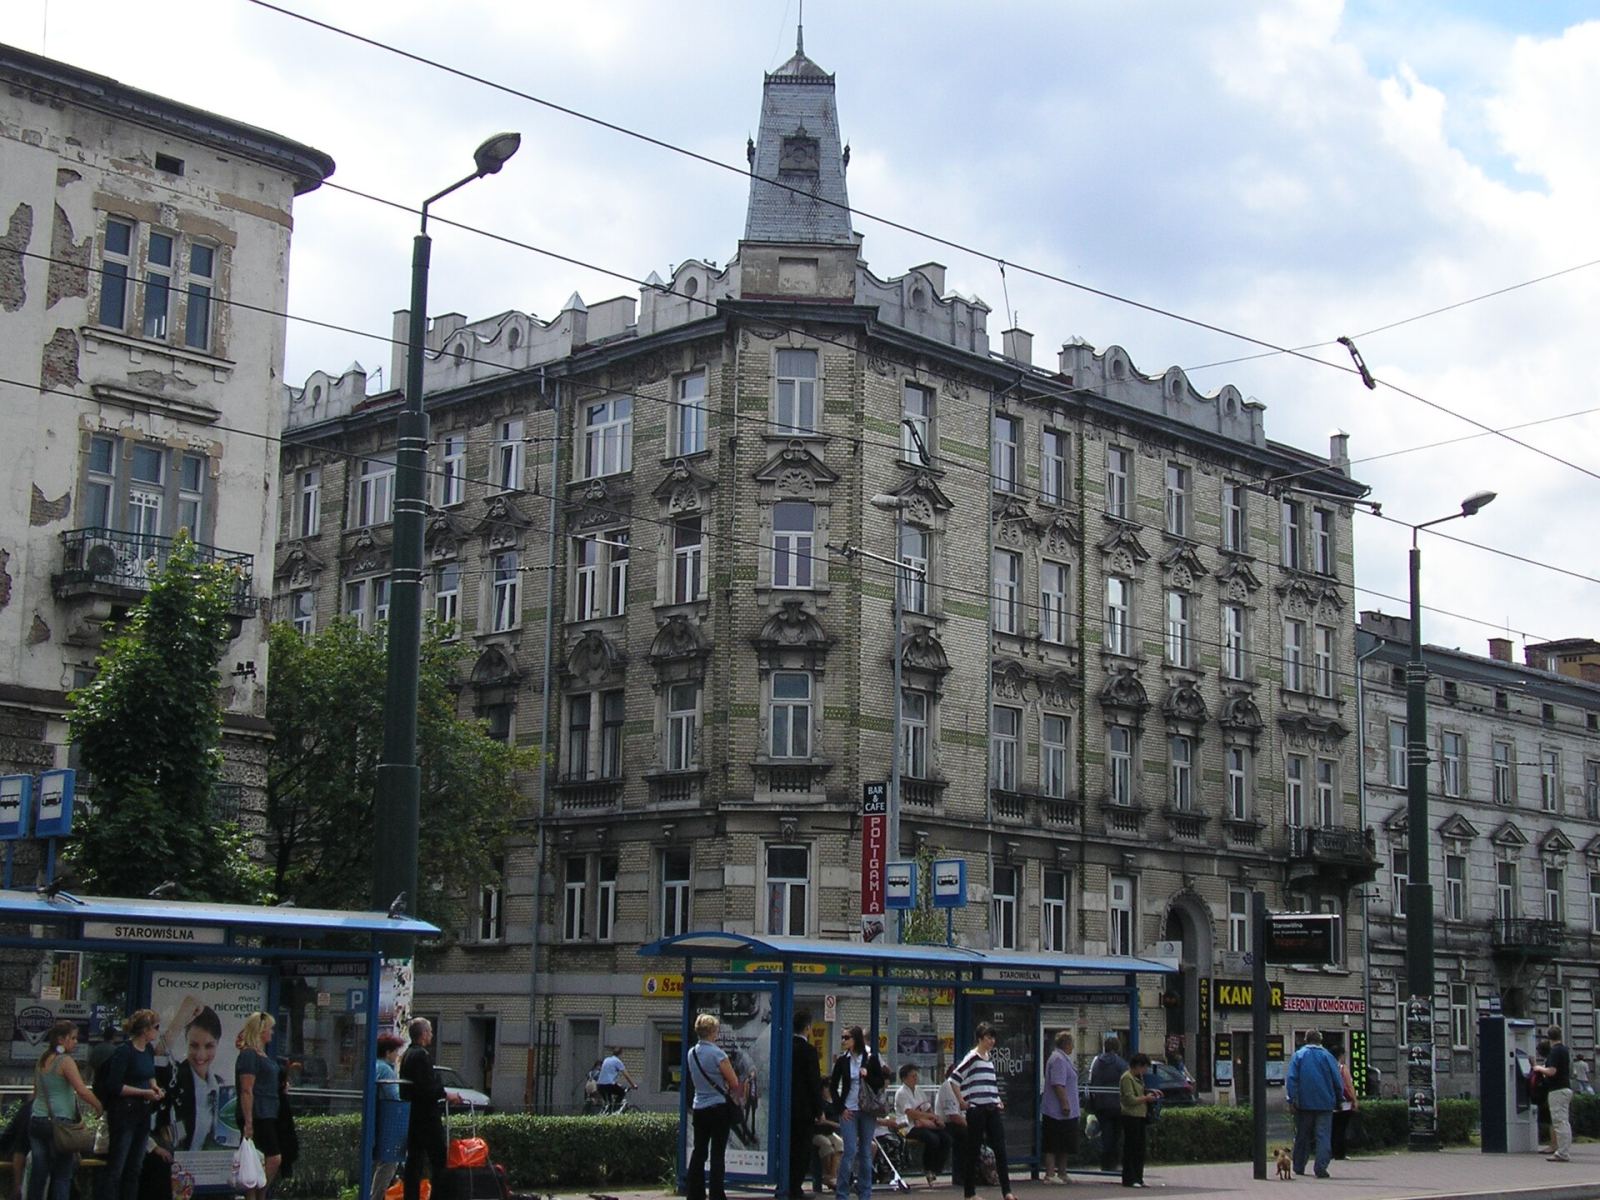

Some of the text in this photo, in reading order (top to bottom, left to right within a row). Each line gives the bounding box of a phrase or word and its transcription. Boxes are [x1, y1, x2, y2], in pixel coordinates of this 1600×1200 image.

[867, 786, 883, 795] BAR
[872, 795, 880, 803] &
[869, 817, 881, 912] POLIGAMIA
[115, 925, 195, 940] STAROWIŚLNA
[158, 977, 262, 992] Chcesz papierosa?
[351, 990, 364, 1010] P
[1200, 979, 1208, 1027] ANTYKI
[1219, 985, 1282, 1007] KANR
[214, 1001, 261, 1012] nicorette
[1284, 996, 1365, 1012] ELEFONY KOMÓRKOWE
